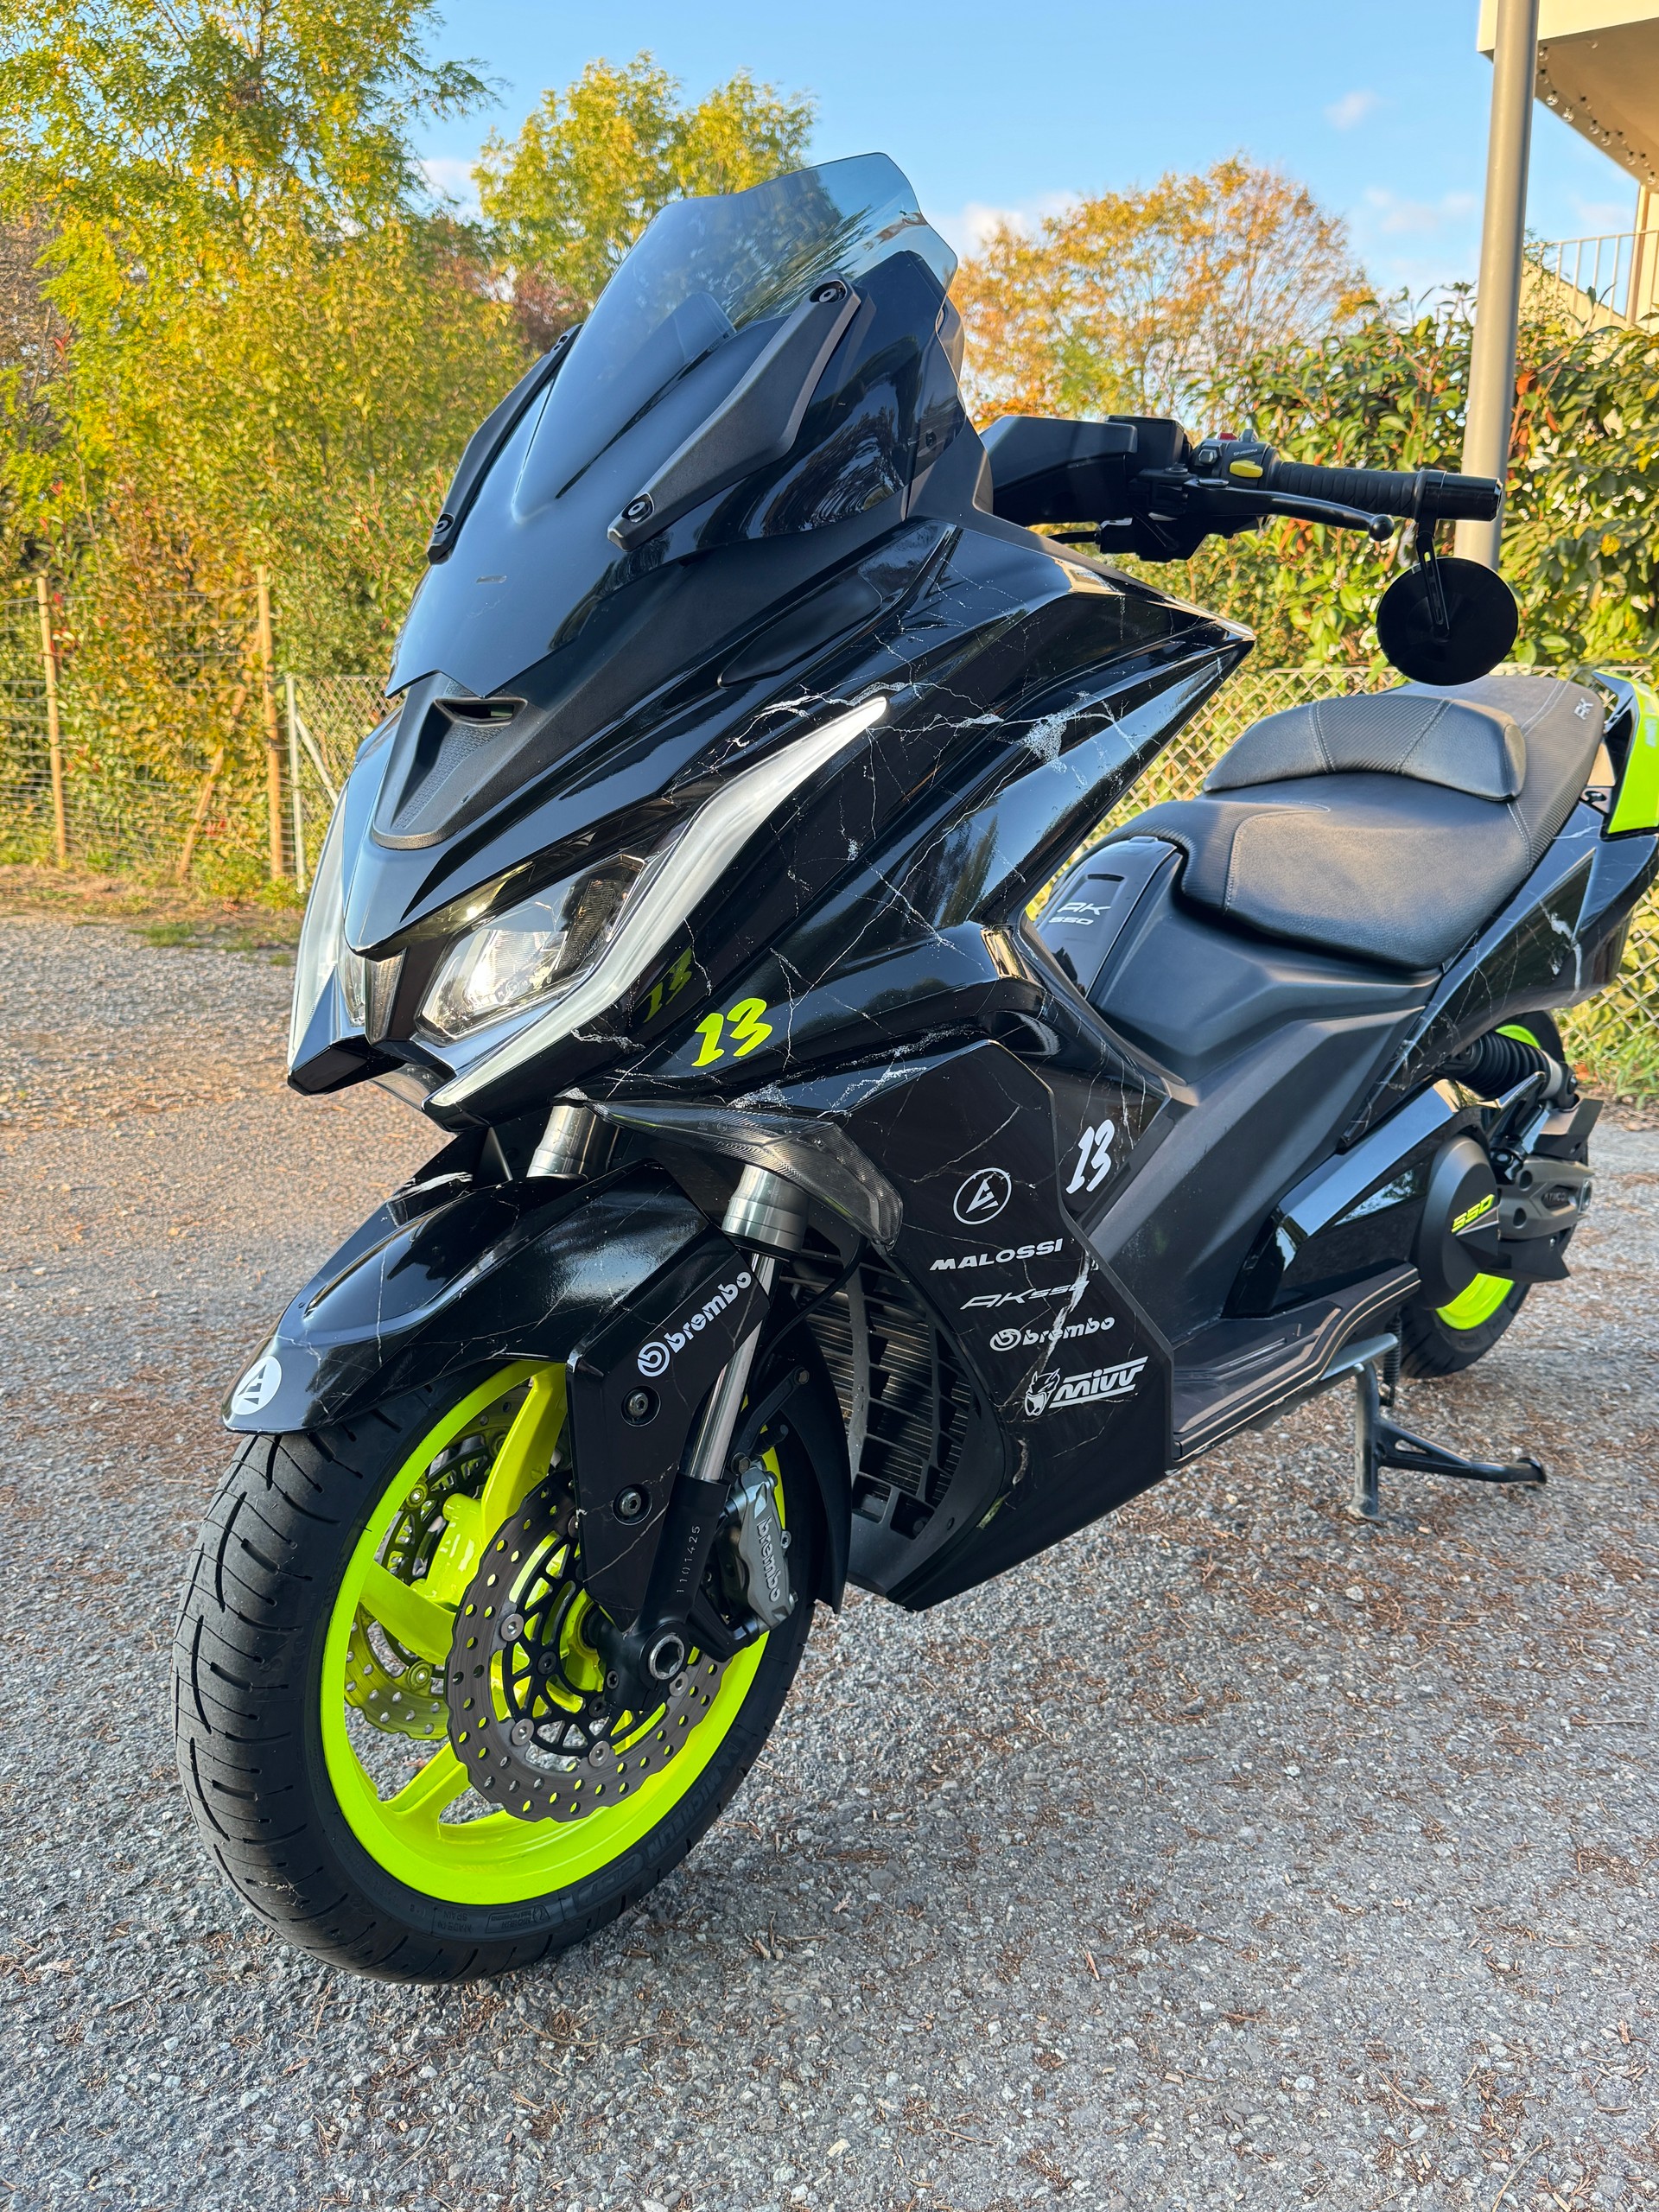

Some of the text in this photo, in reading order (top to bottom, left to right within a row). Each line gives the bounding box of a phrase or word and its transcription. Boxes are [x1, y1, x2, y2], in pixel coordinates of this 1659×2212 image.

[1048, 916, 1095, 925] 550
[1057, 902, 1112, 916] AK
[691, 997, 773, 1067] 13
[1065, 1119, 1116, 1194] 13
[1451, 1193, 1495, 1234] 550
[929, 1238, 1064, 1271] MALOSSI
[664, 1272, 753, 1354] brembo
[1022, 1317, 1116, 1345] brembo
[757, 1516, 781, 1603] brembo
[646, 1767, 723, 1855] MICHELIN
